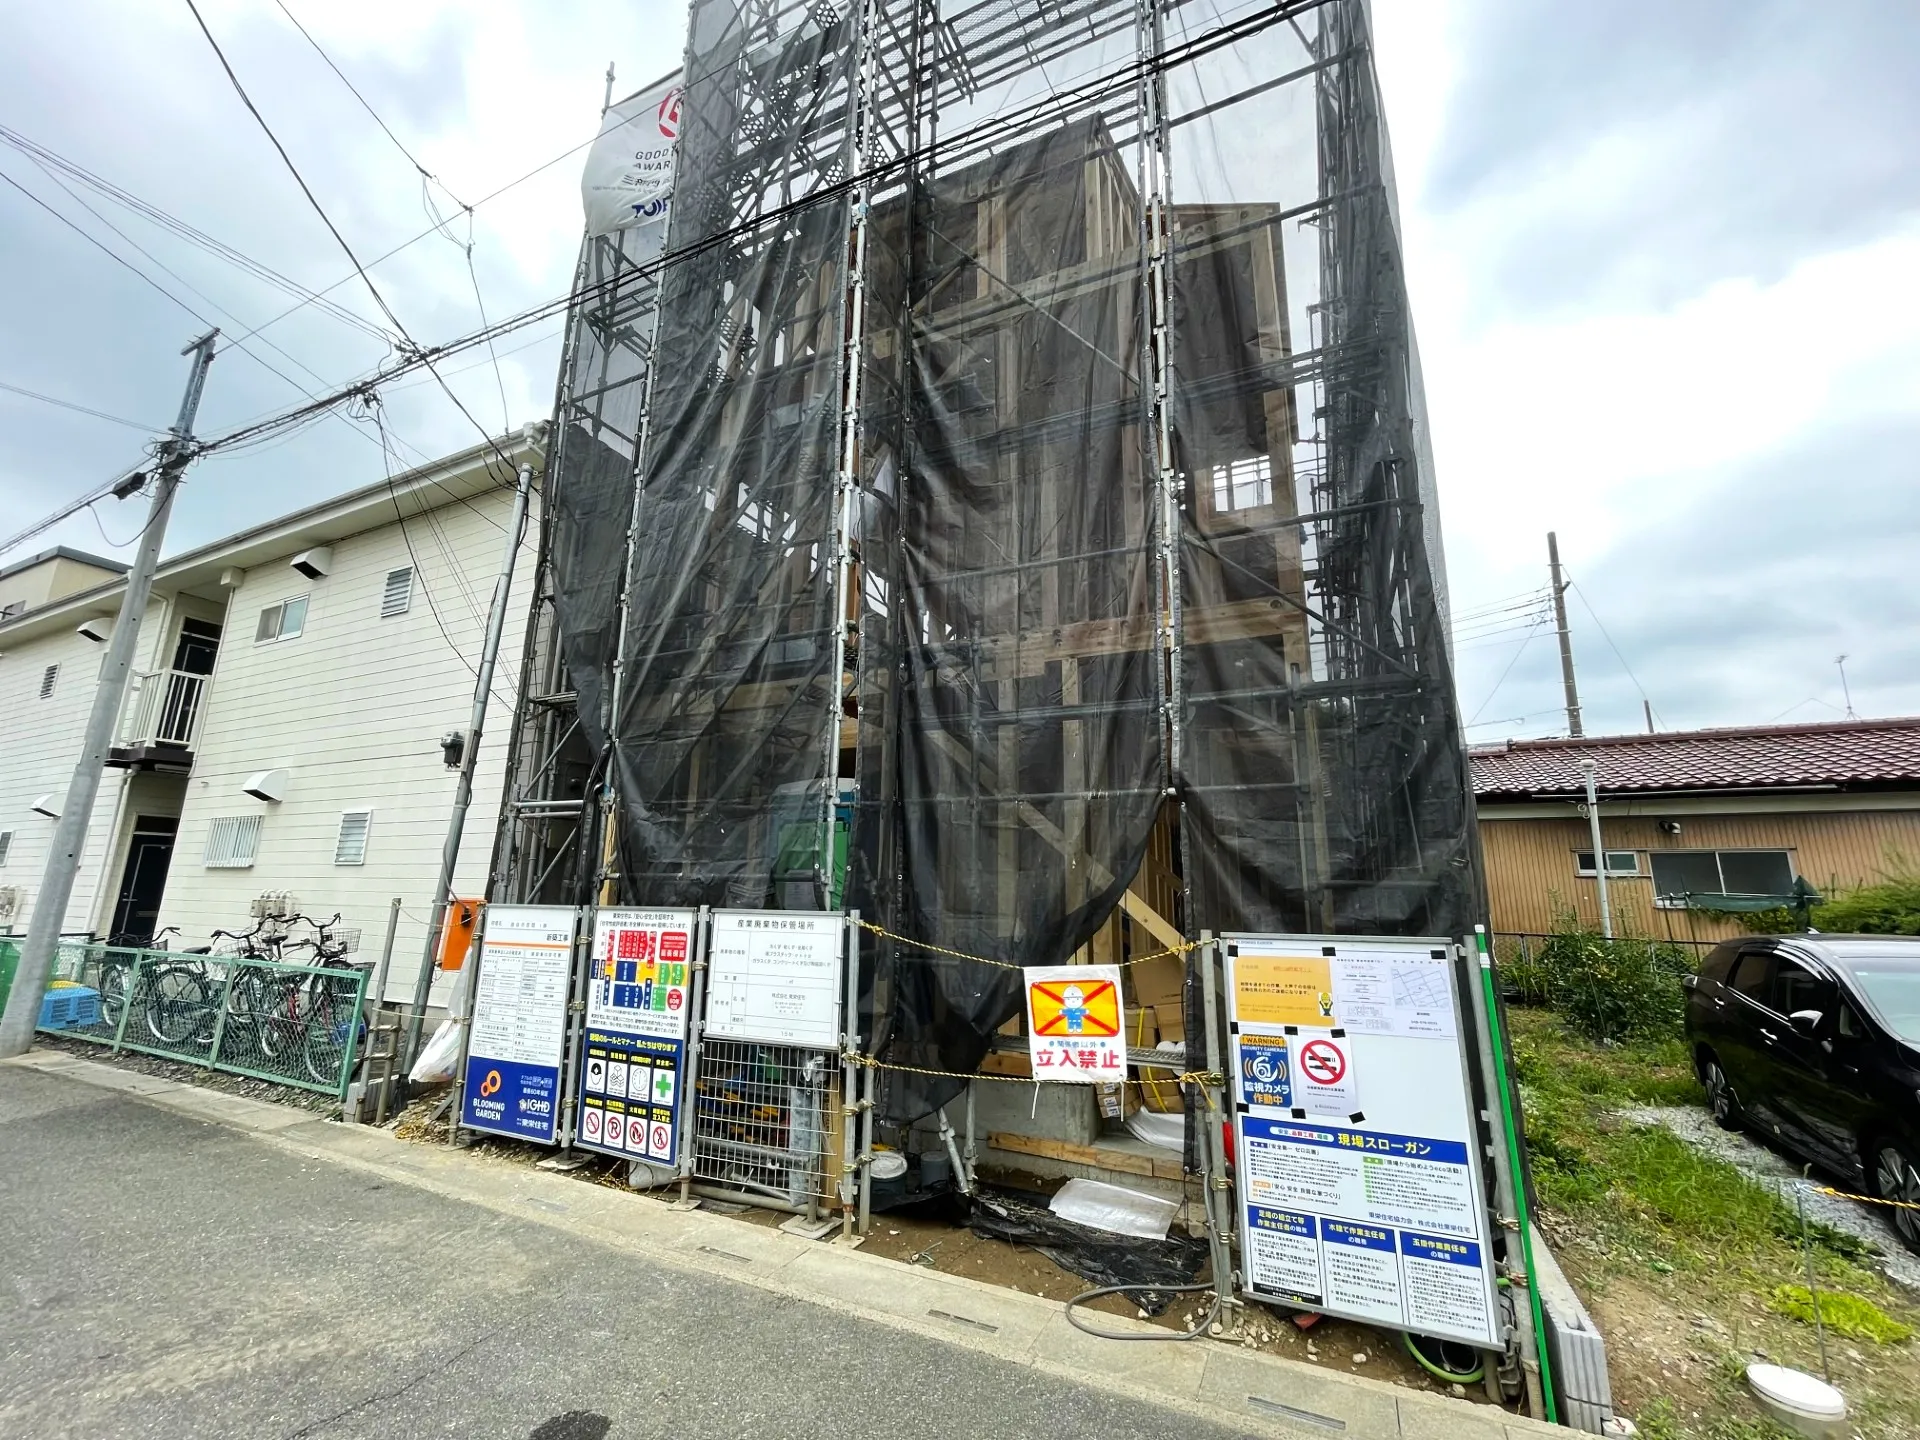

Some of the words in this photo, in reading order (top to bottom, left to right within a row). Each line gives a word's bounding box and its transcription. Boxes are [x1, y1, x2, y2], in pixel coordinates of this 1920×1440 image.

[635, 148, 669, 160] GOOD
[633, 160, 673, 171] AWAR
[737, 919, 815, 931] 産業廃棄物保管場所
[1057, 1040, 1097, 1049] 関係者以外
[1246, 1037, 1281, 1046] WARNING
[1036, 1049, 1121, 1069] 立入禁止
[1244, 1081, 1290, 1095] 監視カメラ
[473, 1097, 505, 1111] BLOOMING
[527, 1098, 550, 1112] IGHD
[1253, 1093, 1283, 1106] 作動中
[475, 1108, 501, 1121] GARDEN
[1337, 1132, 1432, 1156] 現場スローガン
